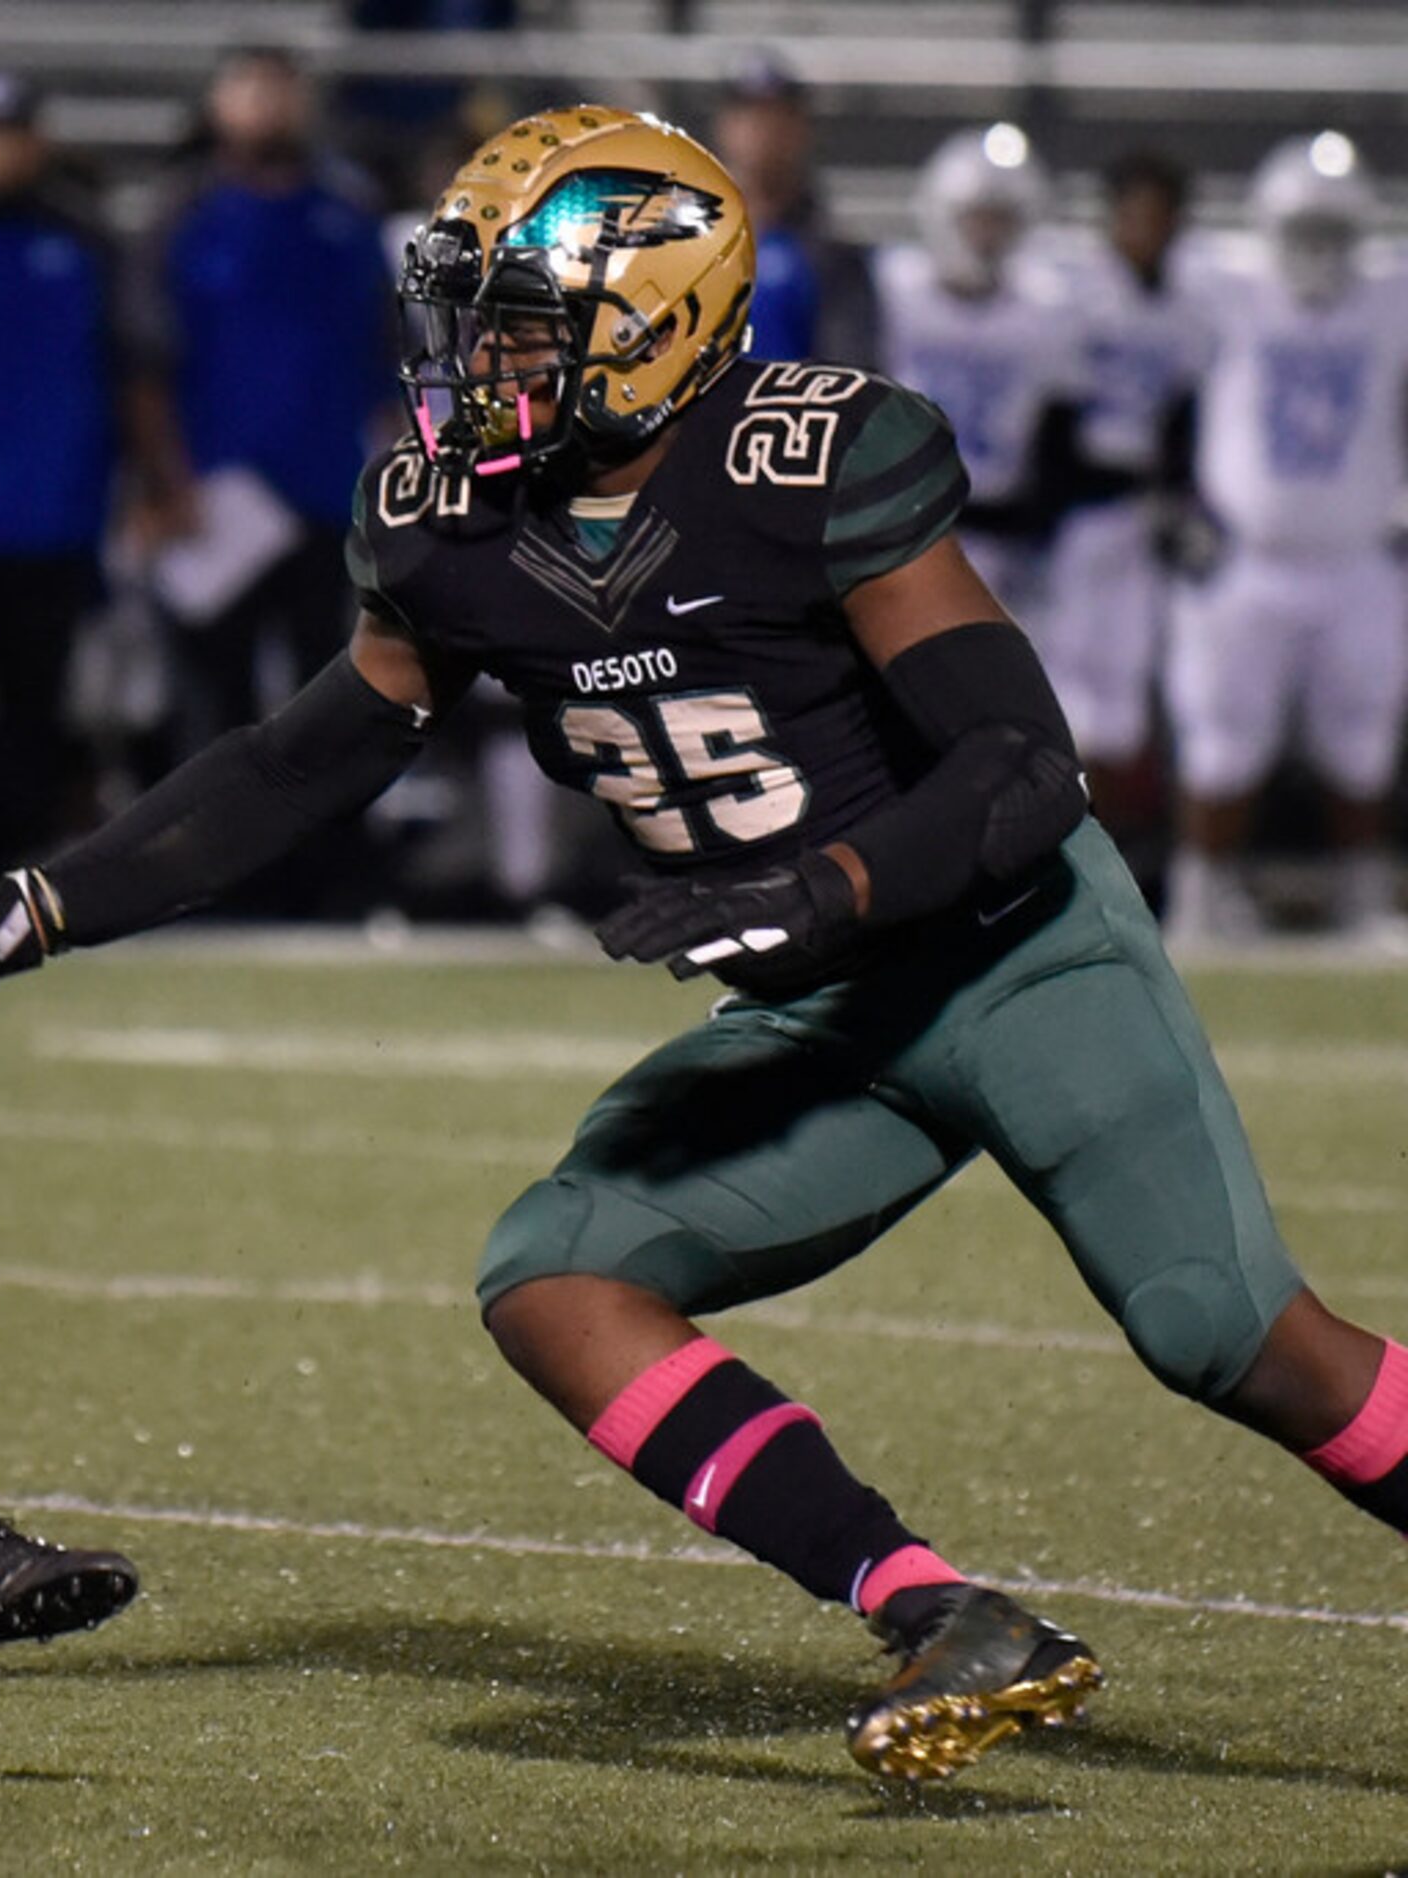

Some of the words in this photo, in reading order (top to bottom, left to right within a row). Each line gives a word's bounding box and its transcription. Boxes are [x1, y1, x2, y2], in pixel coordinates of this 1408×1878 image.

[726, 362, 867, 485] 25
[572, 648, 677, 693] DESOTO
[555, 686, 810, 853] 25
